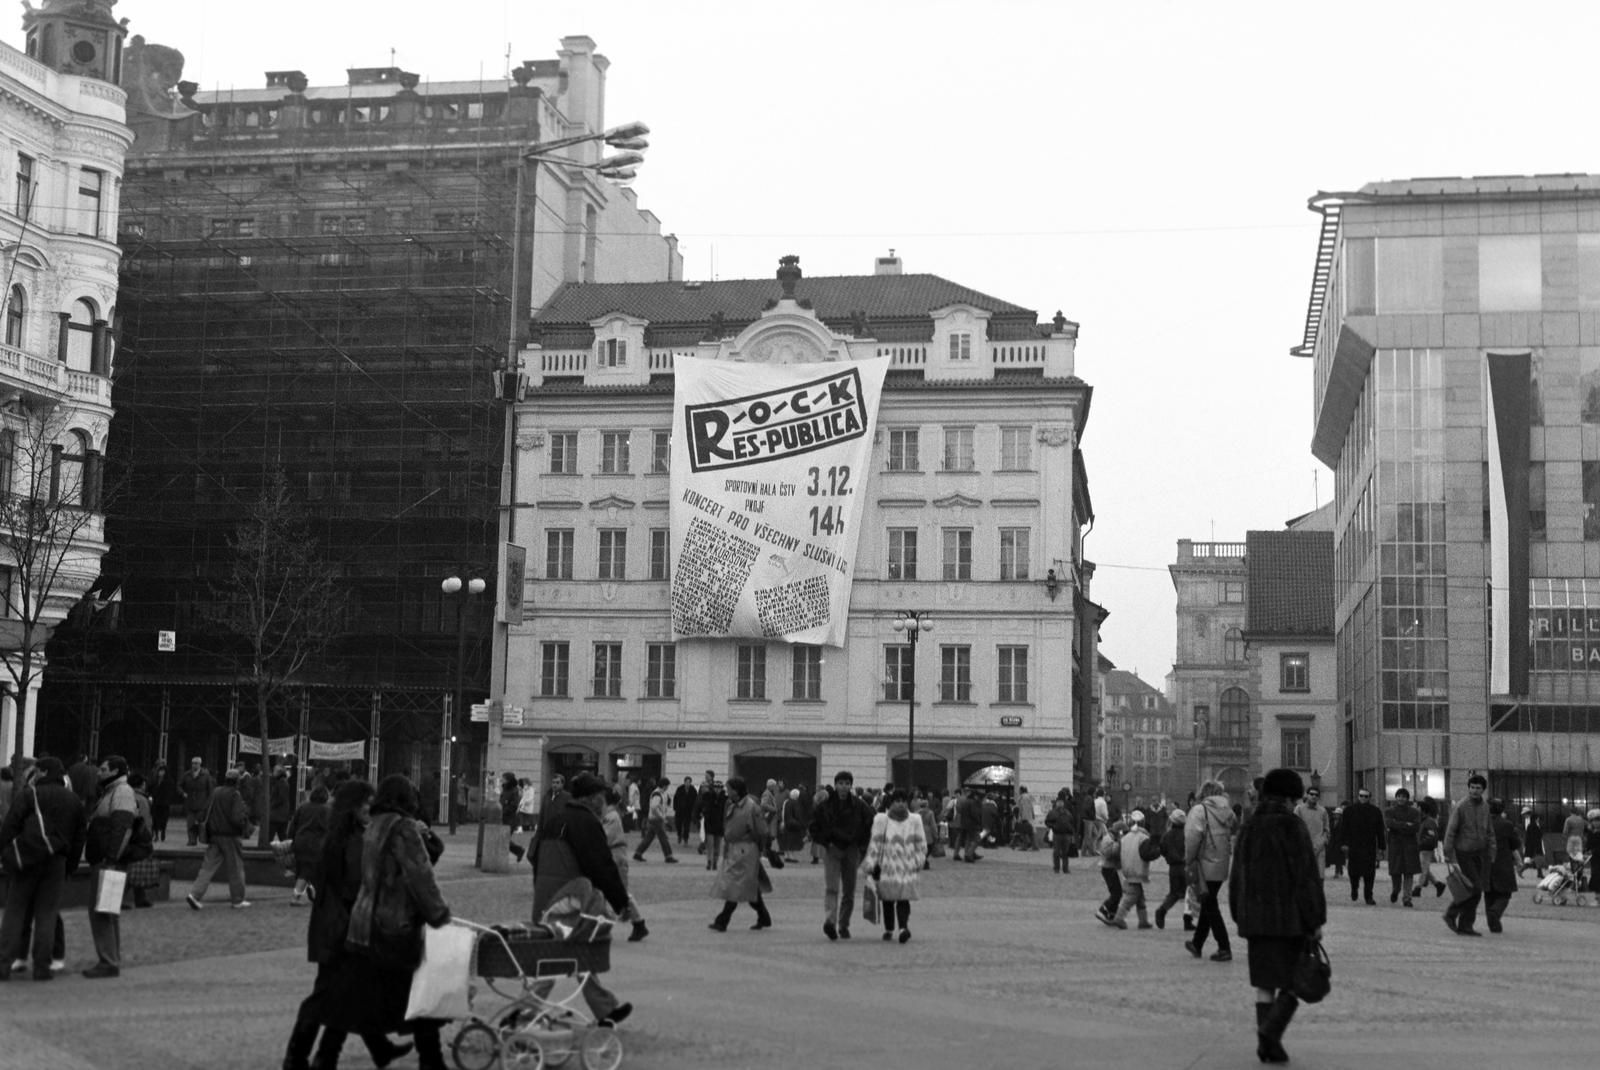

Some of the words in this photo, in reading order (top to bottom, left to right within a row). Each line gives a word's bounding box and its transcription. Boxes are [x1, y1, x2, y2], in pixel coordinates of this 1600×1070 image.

[759, 482, 777, 496] HALA
[779, 481, 797, 497] ČSTV
[807, 465, 853, 497] 3.12.
[682, 488, 725, 519] KONCERT
[726, 510, 750, 531] PRO
[753, 522, 800, 552] VŠECHNY
[809, 505, 845, 536] 14h
